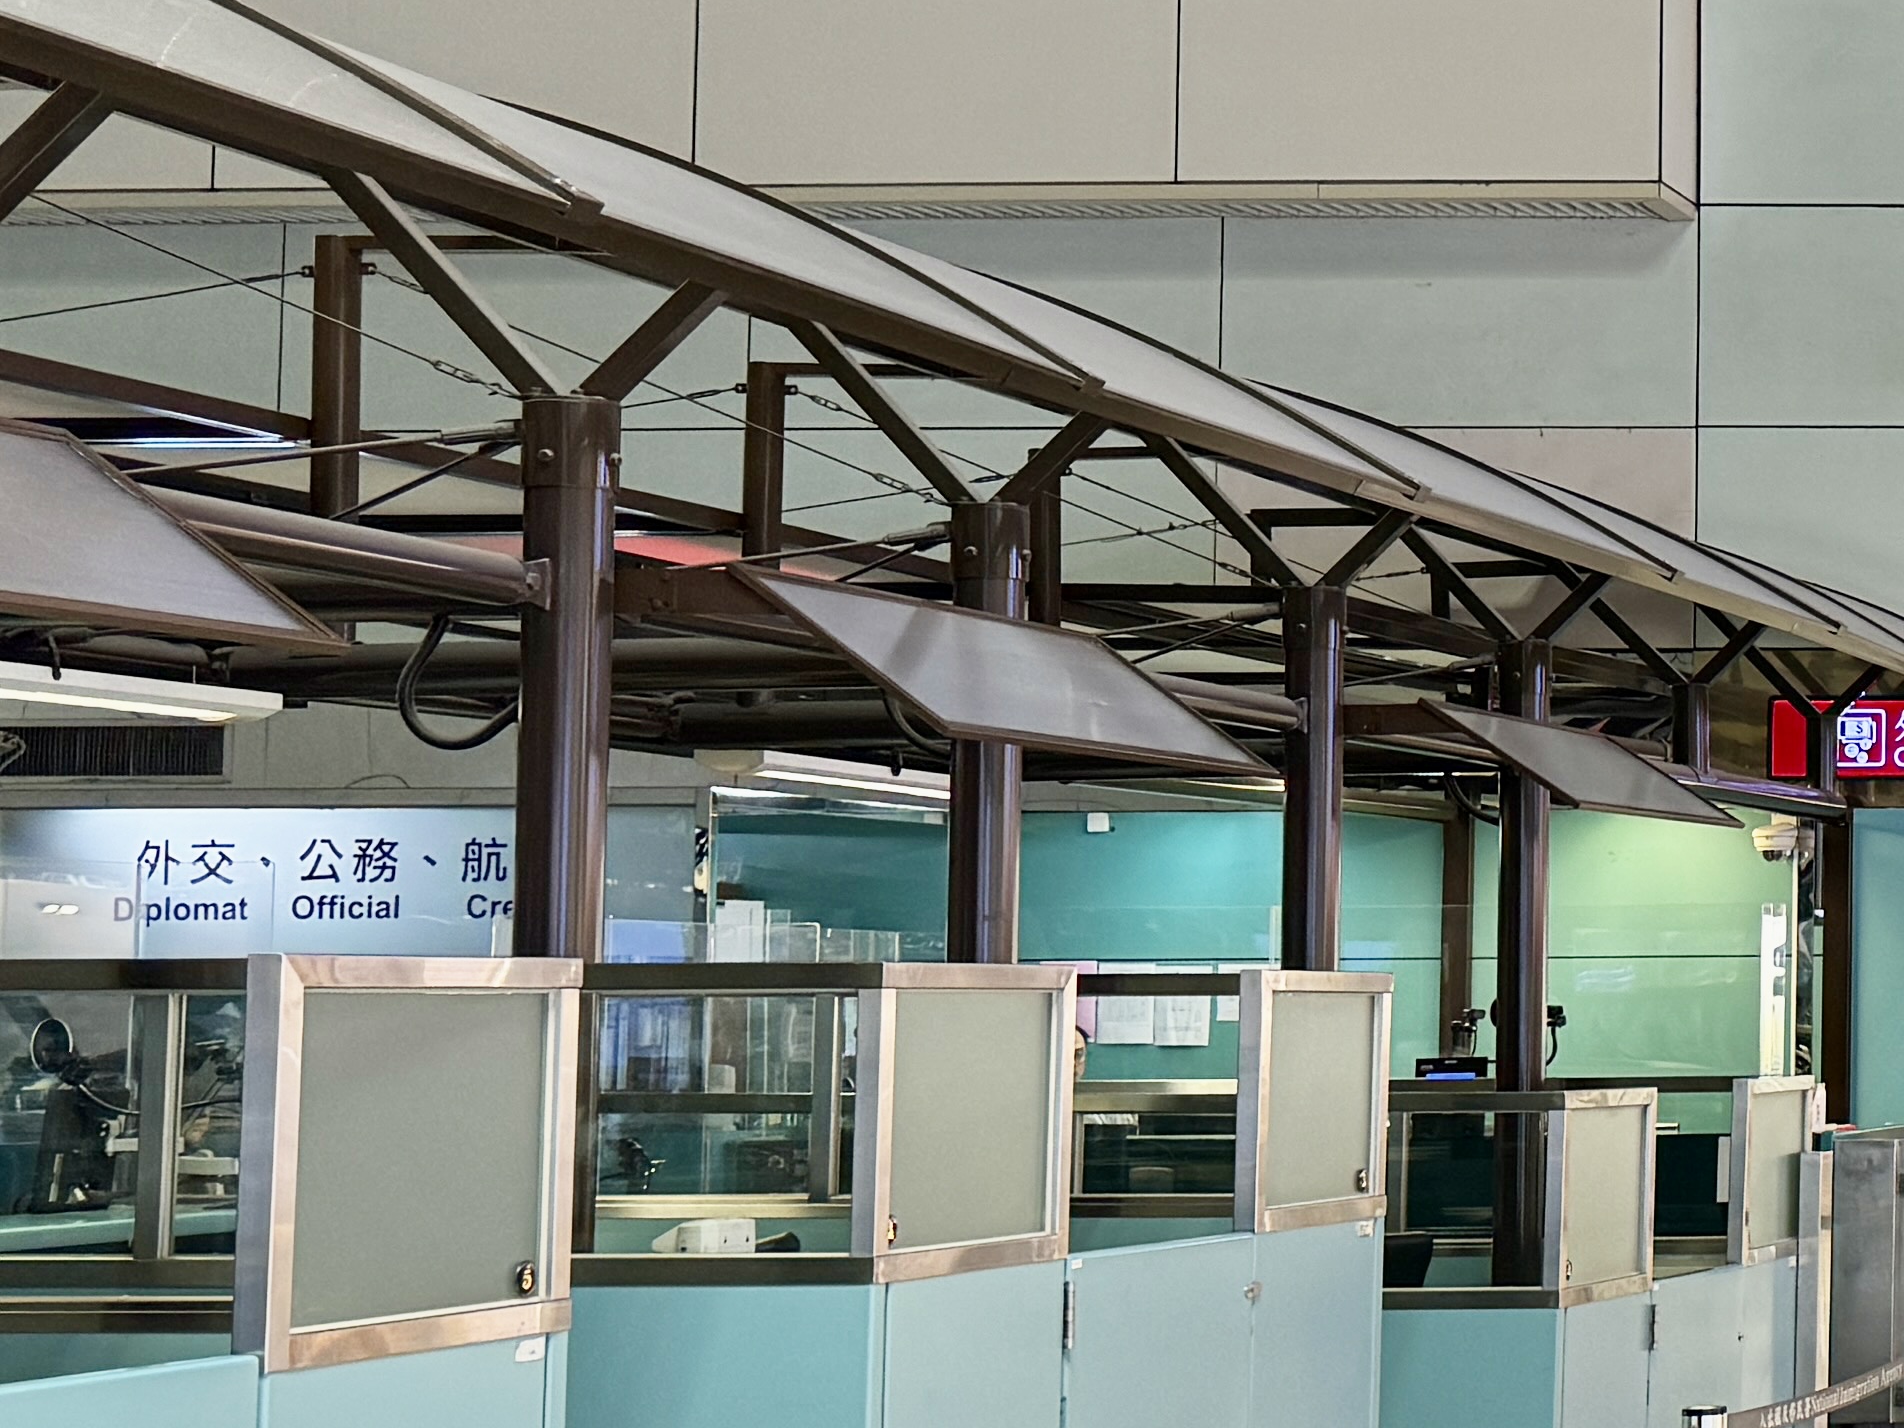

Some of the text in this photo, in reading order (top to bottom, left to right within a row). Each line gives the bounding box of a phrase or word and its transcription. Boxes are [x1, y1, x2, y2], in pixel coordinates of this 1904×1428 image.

[113, 893, 514, 927] Dplomat Official Cre
[520, 1266, 534, 1292] 5
